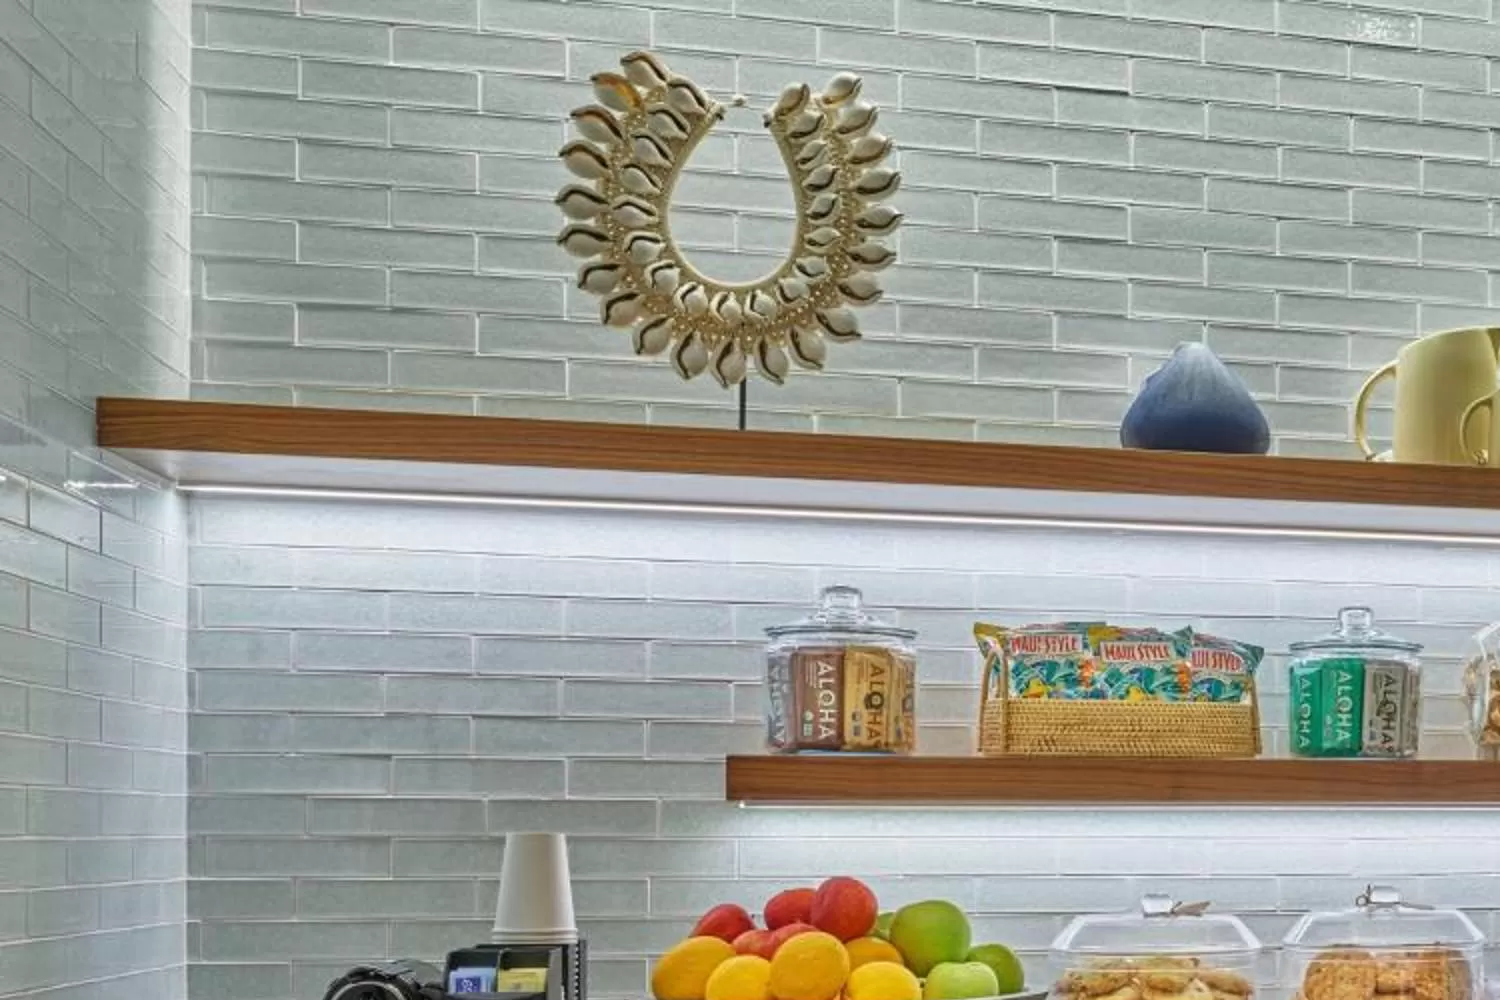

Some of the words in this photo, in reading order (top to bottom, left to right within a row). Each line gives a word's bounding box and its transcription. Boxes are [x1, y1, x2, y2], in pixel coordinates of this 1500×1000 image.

[1038, 636, 1077, 653] STYLE
[1137, 643, 1170, 660] STYLE
[816, 660, 837, 741] ALOHA
[866, 663, 885, 741] ALOHA
[1299, 677, 1312, 748] ALOHA
[1336, 671, 1352, 742] ALOHA
[1381, 673, 1397, 745] ALOHA
